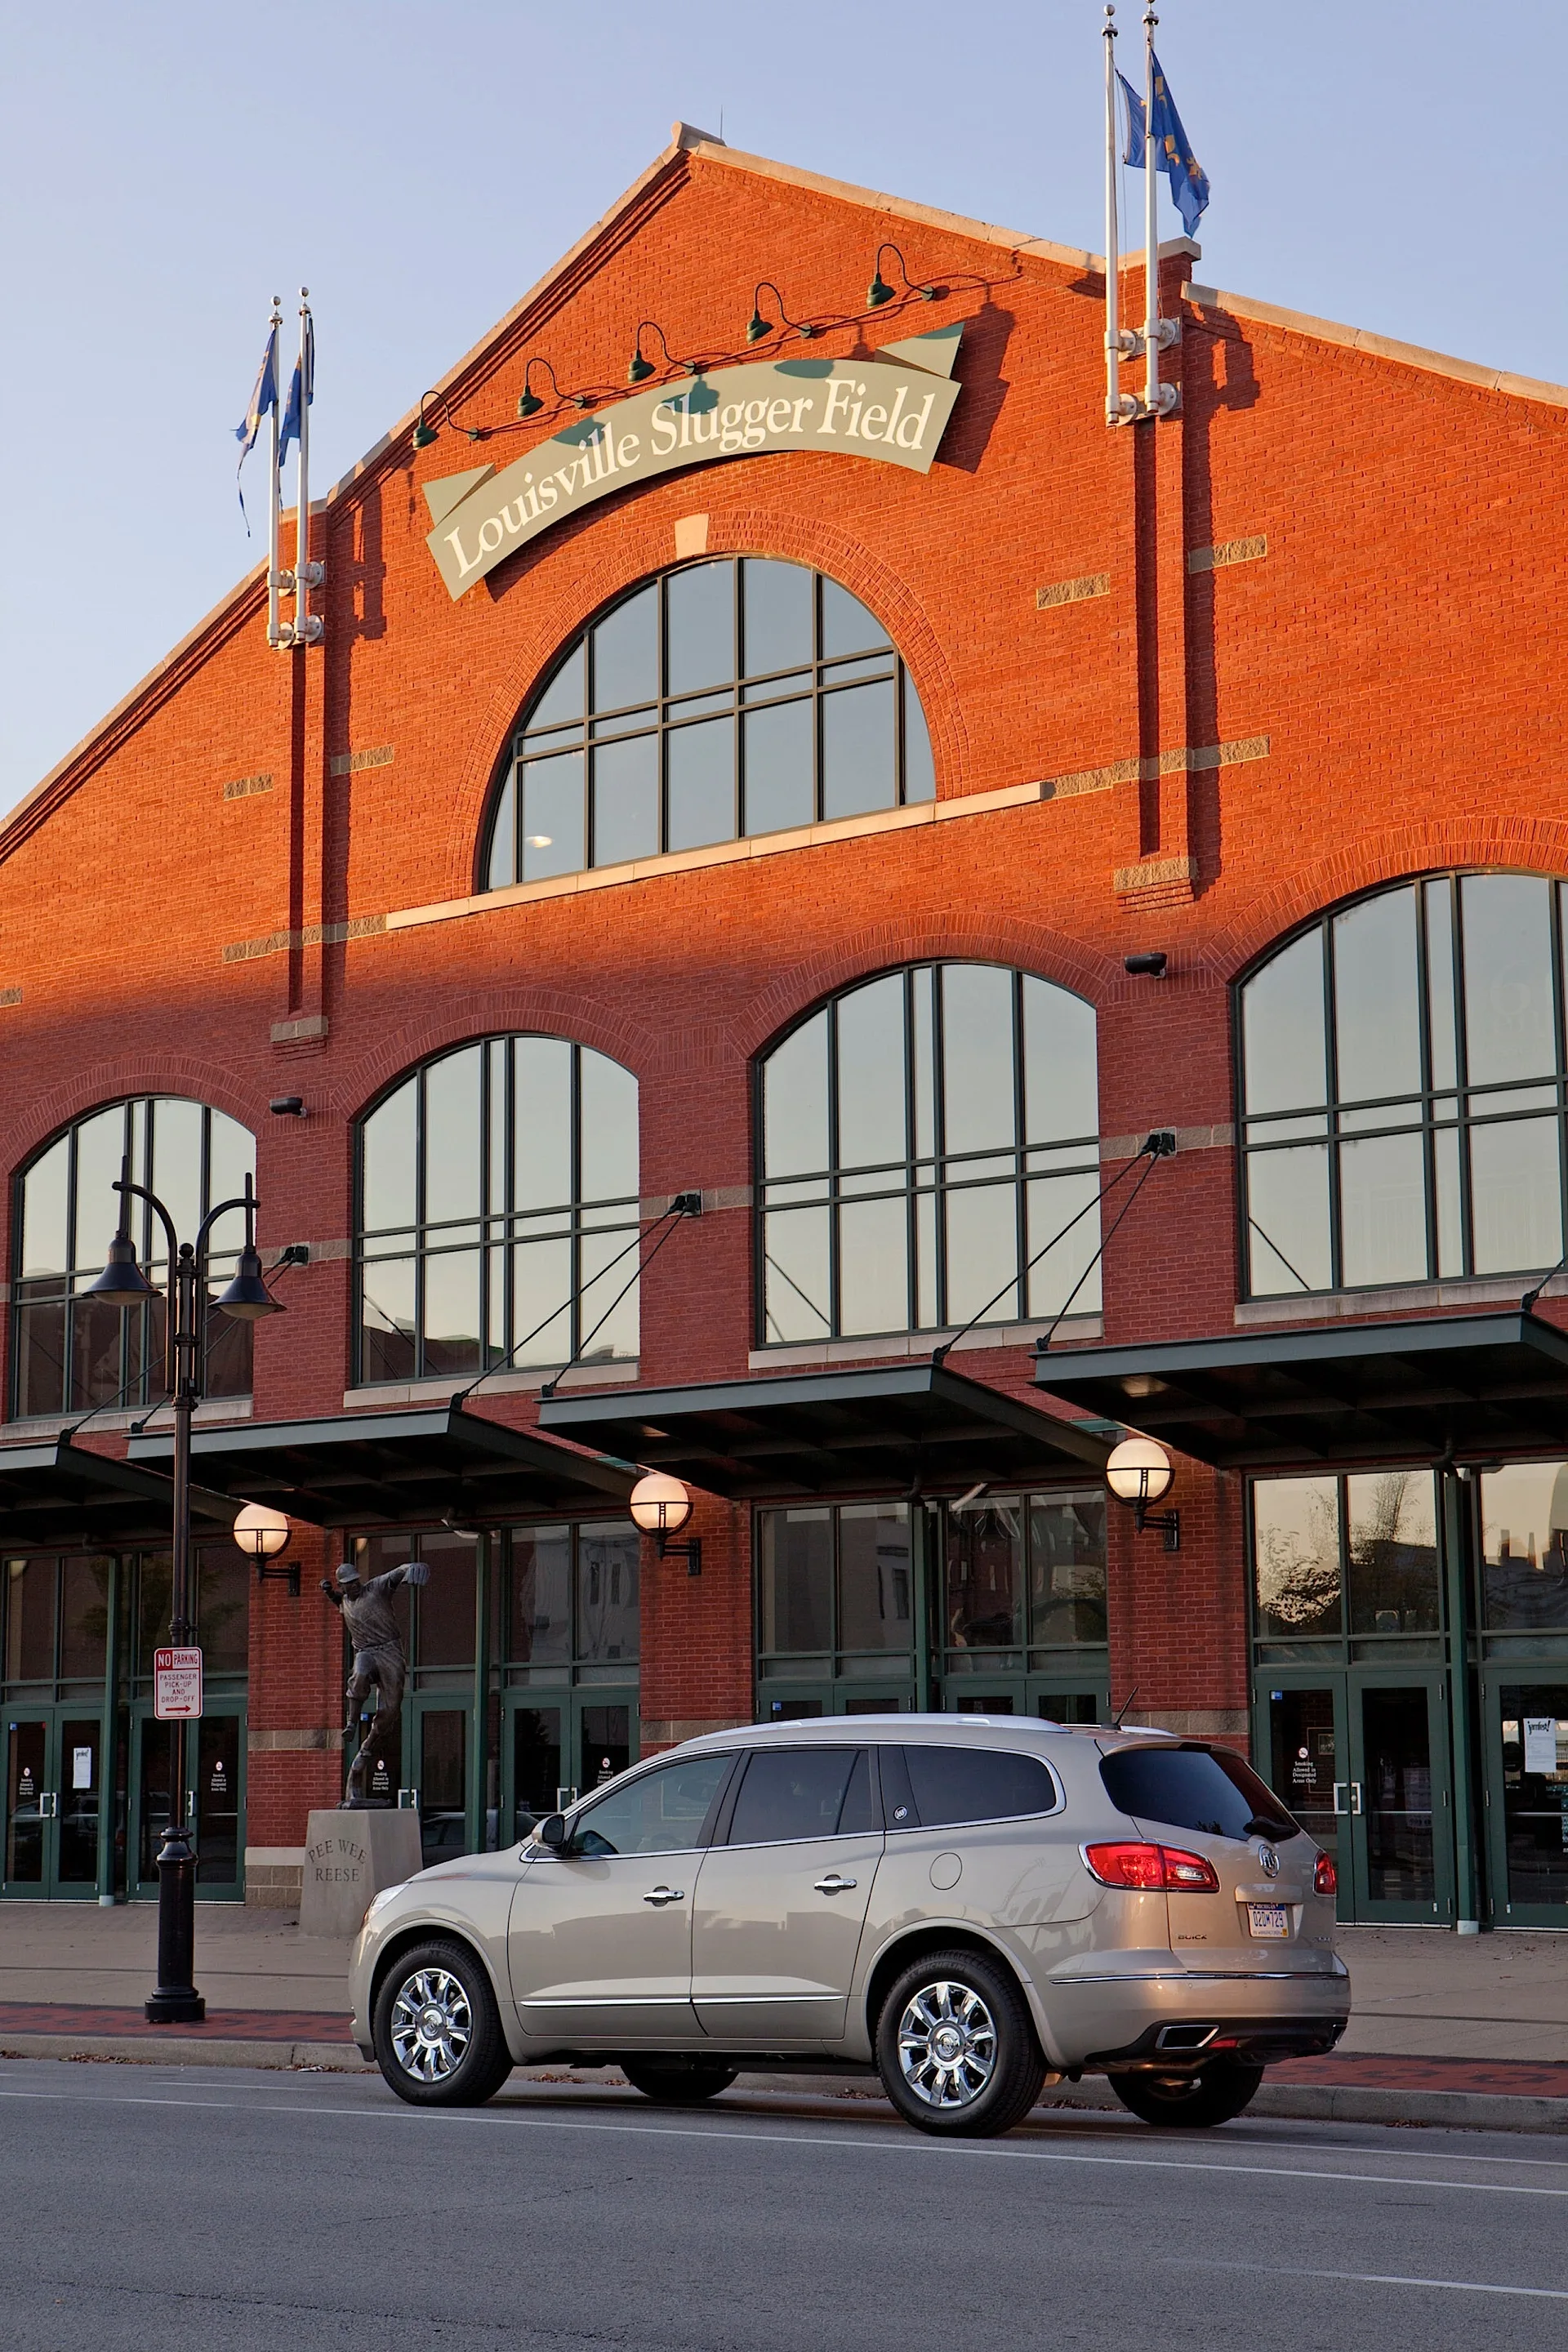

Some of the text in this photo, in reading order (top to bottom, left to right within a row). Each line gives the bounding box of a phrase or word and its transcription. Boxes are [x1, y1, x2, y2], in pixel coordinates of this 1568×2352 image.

[444, 378, 936, 578] Louisville Slugger Field
[158, 1653, 198, 1667] NO PARKING
[161, 1695, 195, 1704] DROP-OFF
[308, 1838, 367, 1864] PEE WEE
[315, 1868, 360, 1882] REESE
